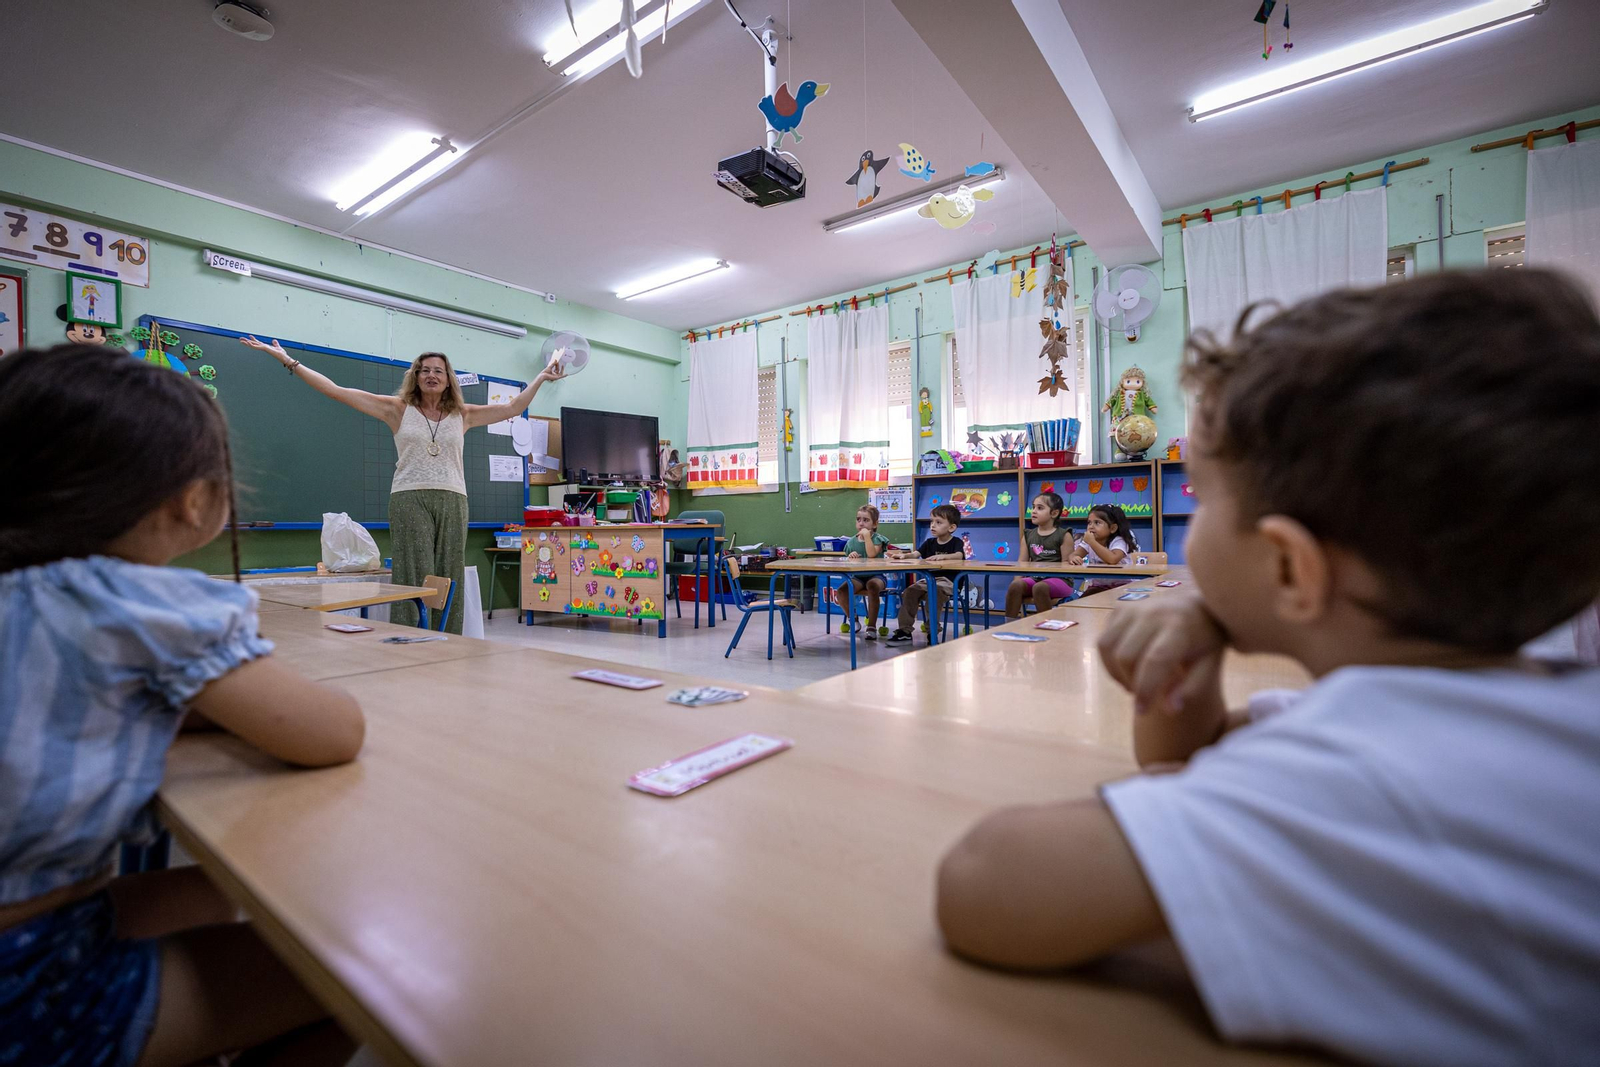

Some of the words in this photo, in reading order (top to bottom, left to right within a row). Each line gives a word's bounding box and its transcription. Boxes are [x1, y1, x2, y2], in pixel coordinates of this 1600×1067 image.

[4, 211, 28, 237] 7
[45, 222, 69, 248] 8
[83, 231, 103, 257] 9
[108, 238, 147, 266] 10
